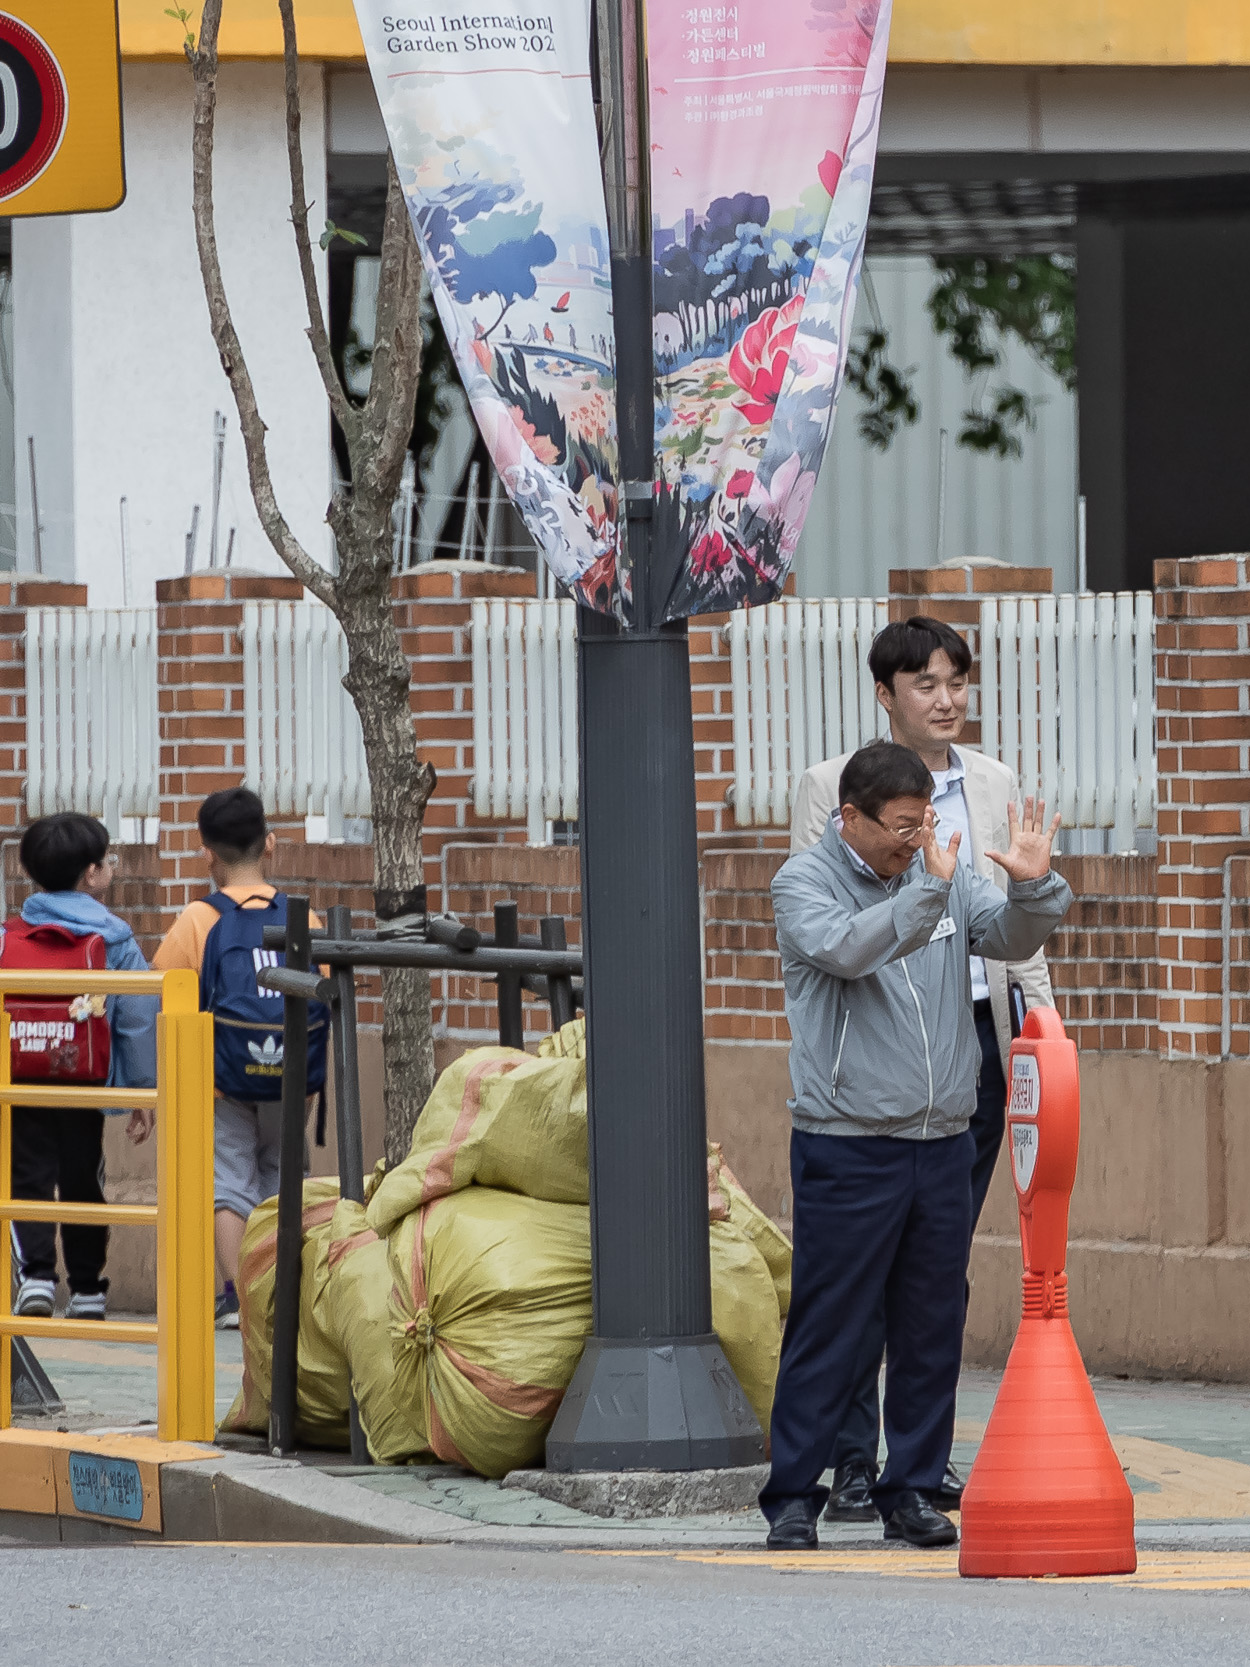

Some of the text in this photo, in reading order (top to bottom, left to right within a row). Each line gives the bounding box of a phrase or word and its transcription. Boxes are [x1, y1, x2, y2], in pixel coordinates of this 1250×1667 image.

[382, 14, 554, 34] Seoul Internationl
[387, 33, 556, 54] Garden Show 202
